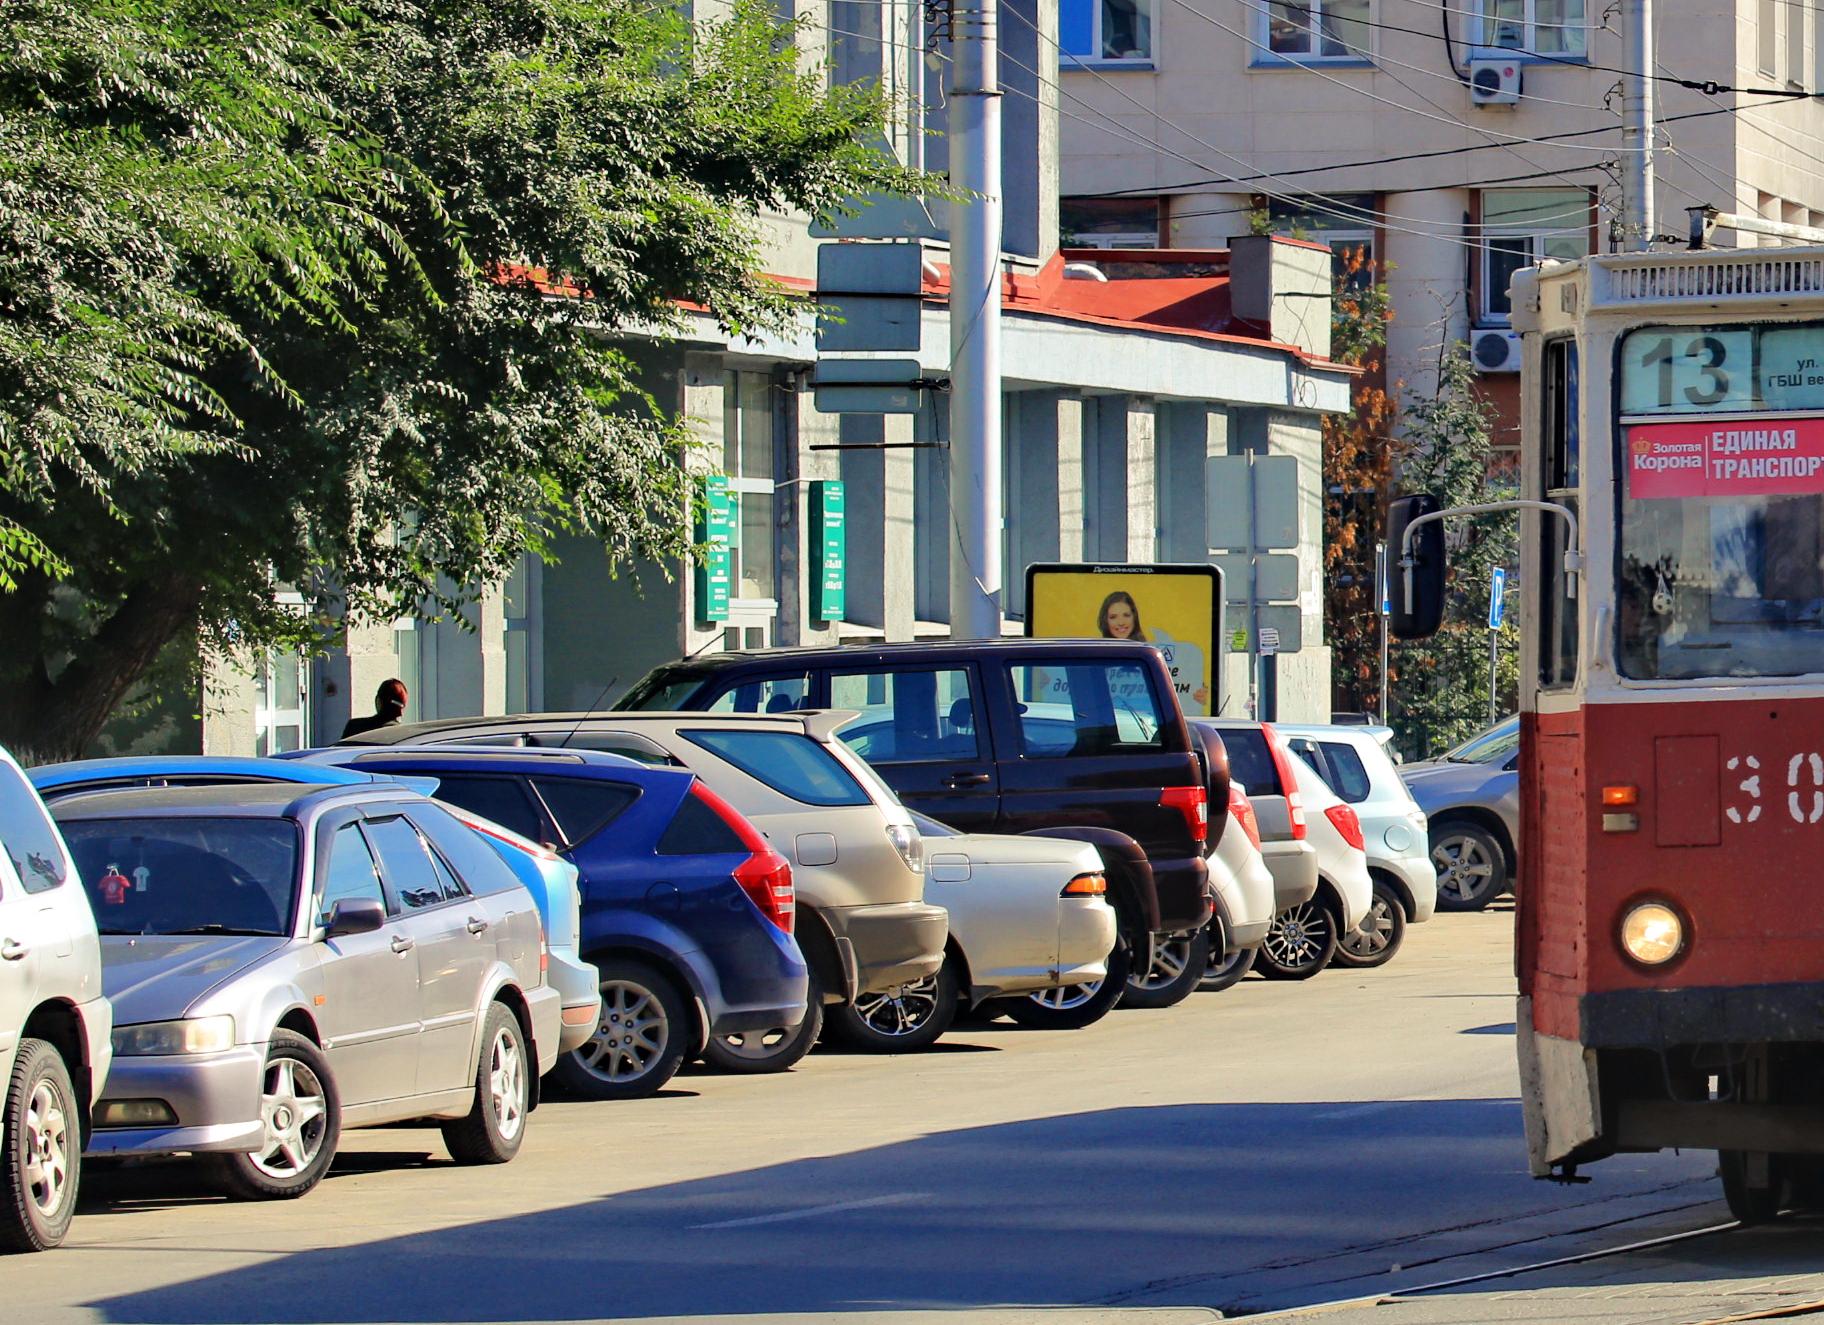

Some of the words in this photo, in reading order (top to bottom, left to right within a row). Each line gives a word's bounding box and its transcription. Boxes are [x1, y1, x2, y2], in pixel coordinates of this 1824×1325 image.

[1641, 336, 1729, 407] 13
[1796, 358, 1819, 371] ул.
[1768, 374, 1803, 388] ГБШ
[1653, 442, 1702, 454] Золотая
[1712, 430, 1796, 455] ЕДИНАЯ
[1634, 454, 1702, 473] Корона
